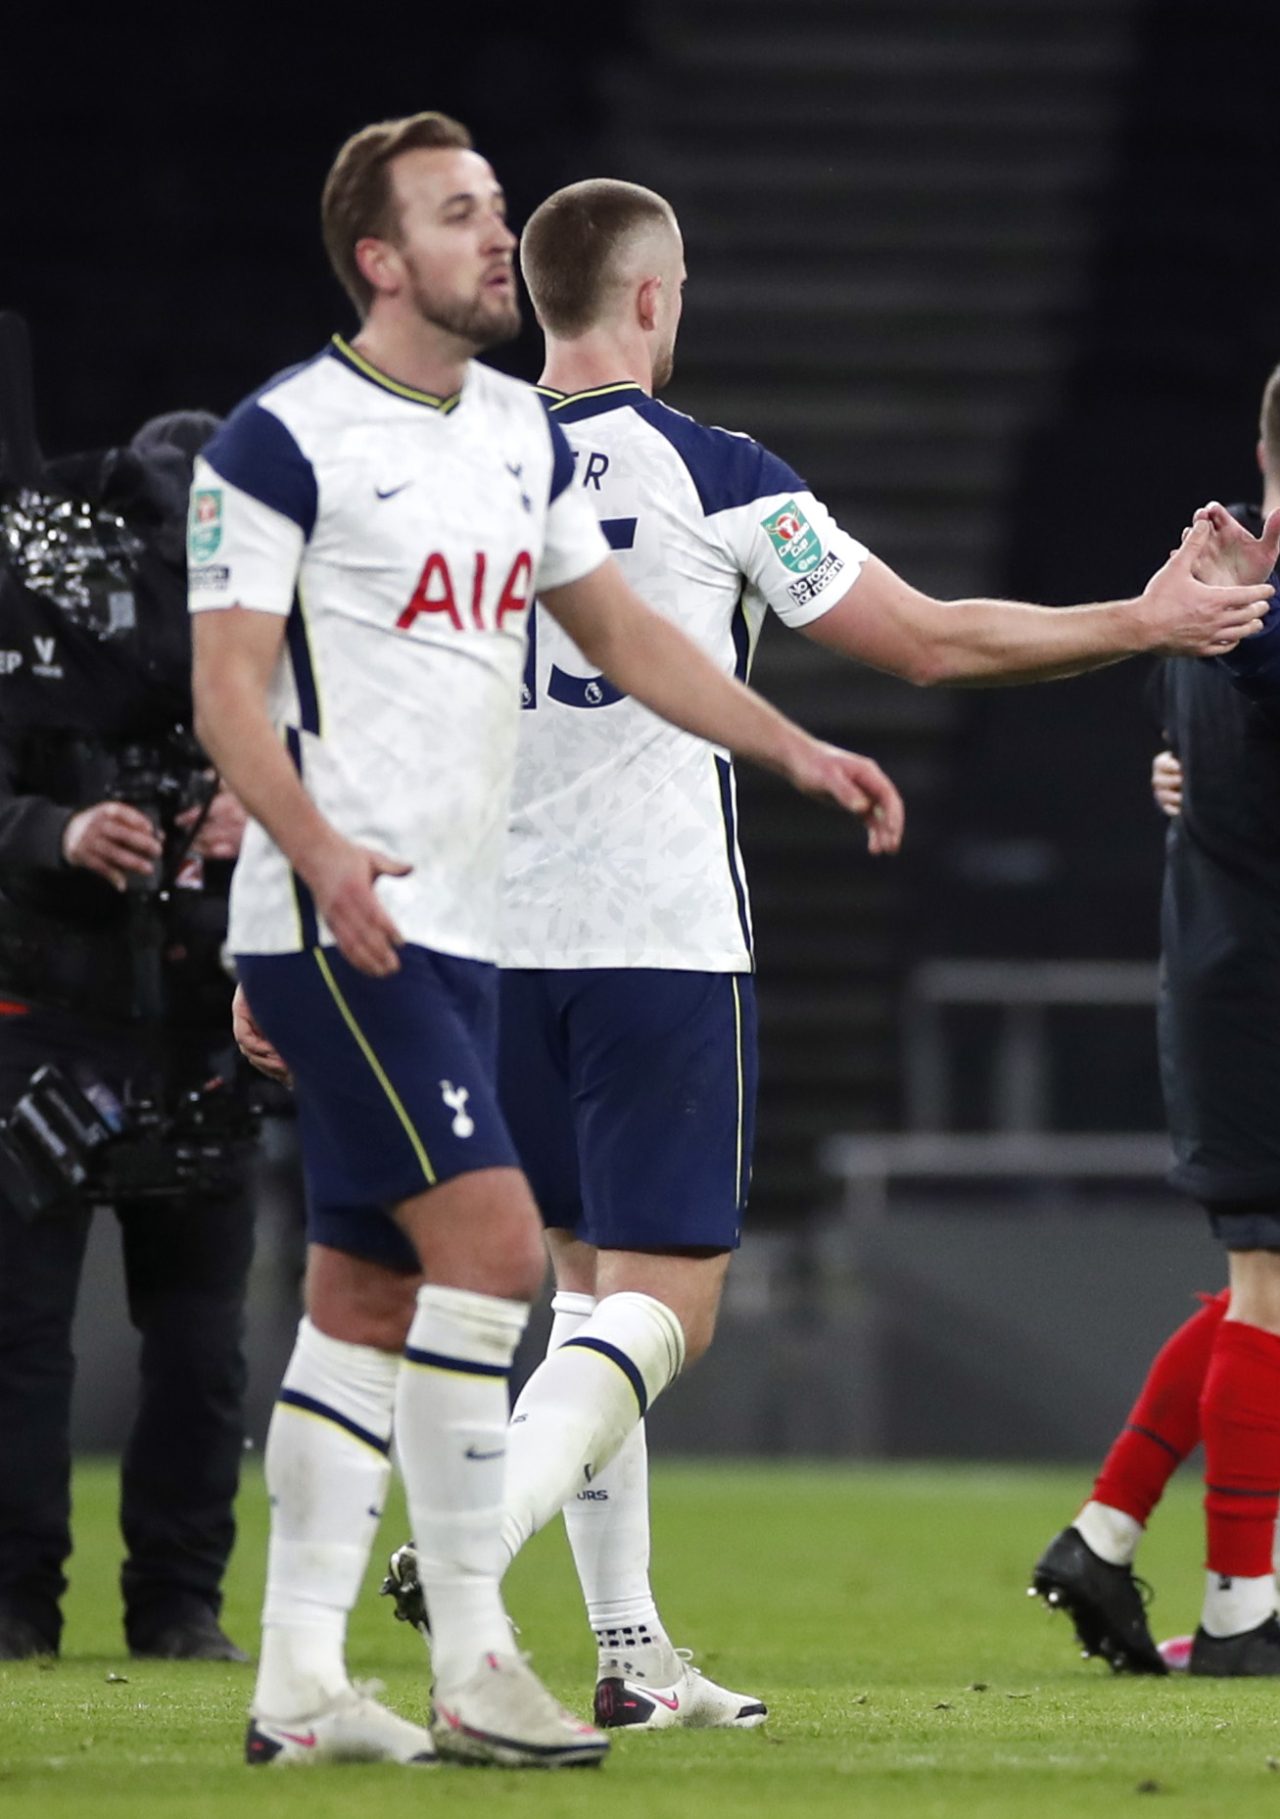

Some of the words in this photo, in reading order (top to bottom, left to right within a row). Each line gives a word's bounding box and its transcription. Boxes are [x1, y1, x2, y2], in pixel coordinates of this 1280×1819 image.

[395, 550, 532, 631] AIA
[787, 579, 809, 597] No
[805, 556, 833, 584] room
